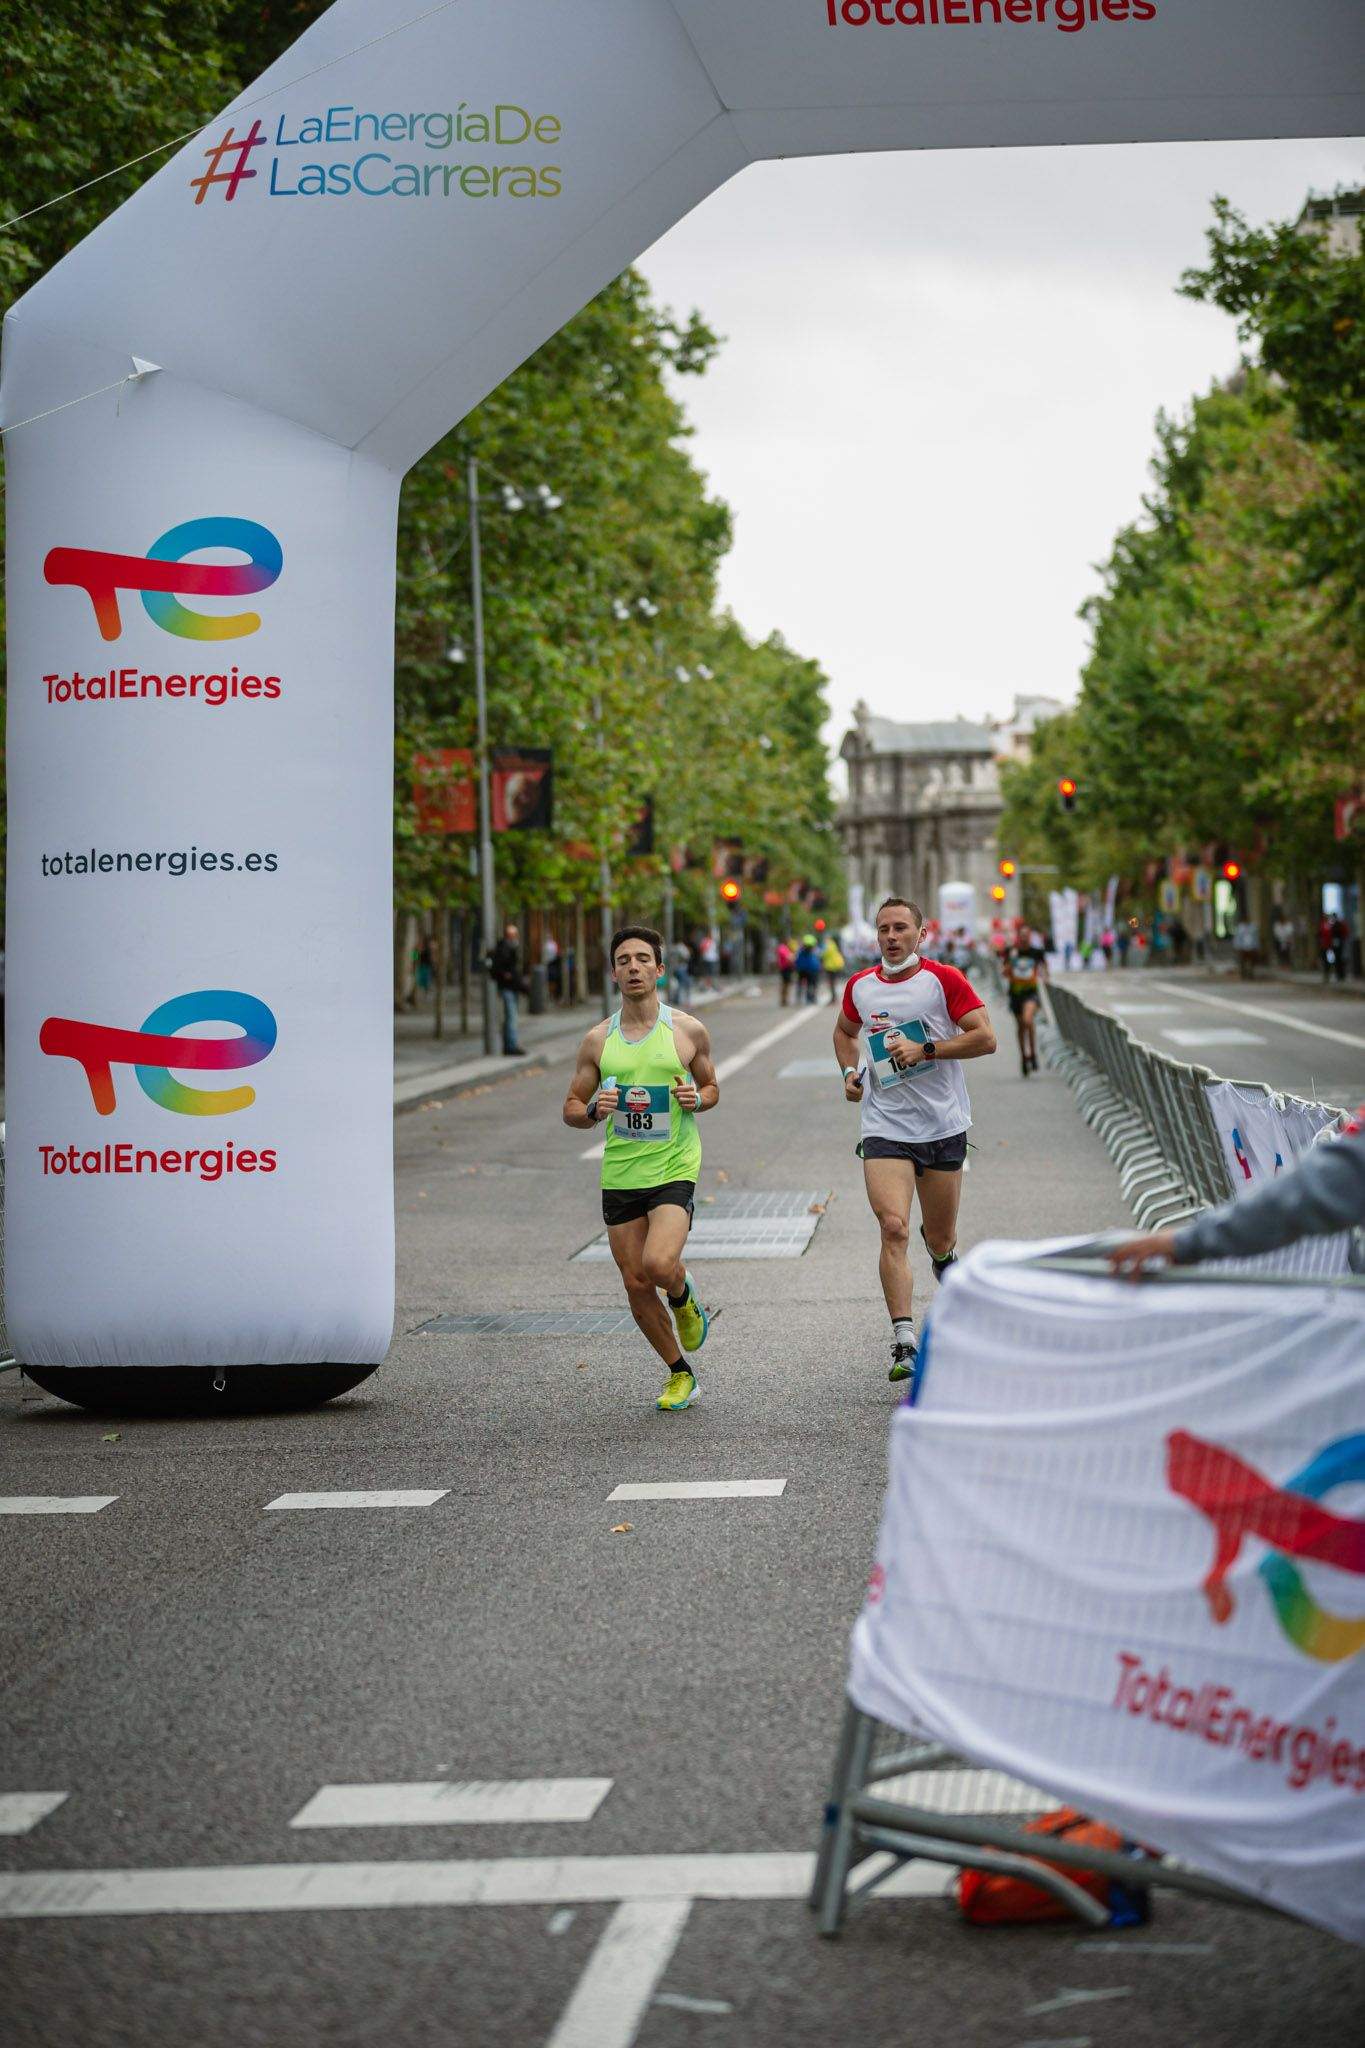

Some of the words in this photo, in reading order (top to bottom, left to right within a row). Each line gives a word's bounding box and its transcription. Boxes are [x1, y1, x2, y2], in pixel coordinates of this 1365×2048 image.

[269, 152, 563, 198] LasCarreras
[43, 666, 282, 706] TotalEnergies
[42, 846, 279, 877] totalenergies.es
[625, 1112, 652, 1130] 183
[39, 1140, 277, 1182] TotalEnergies
